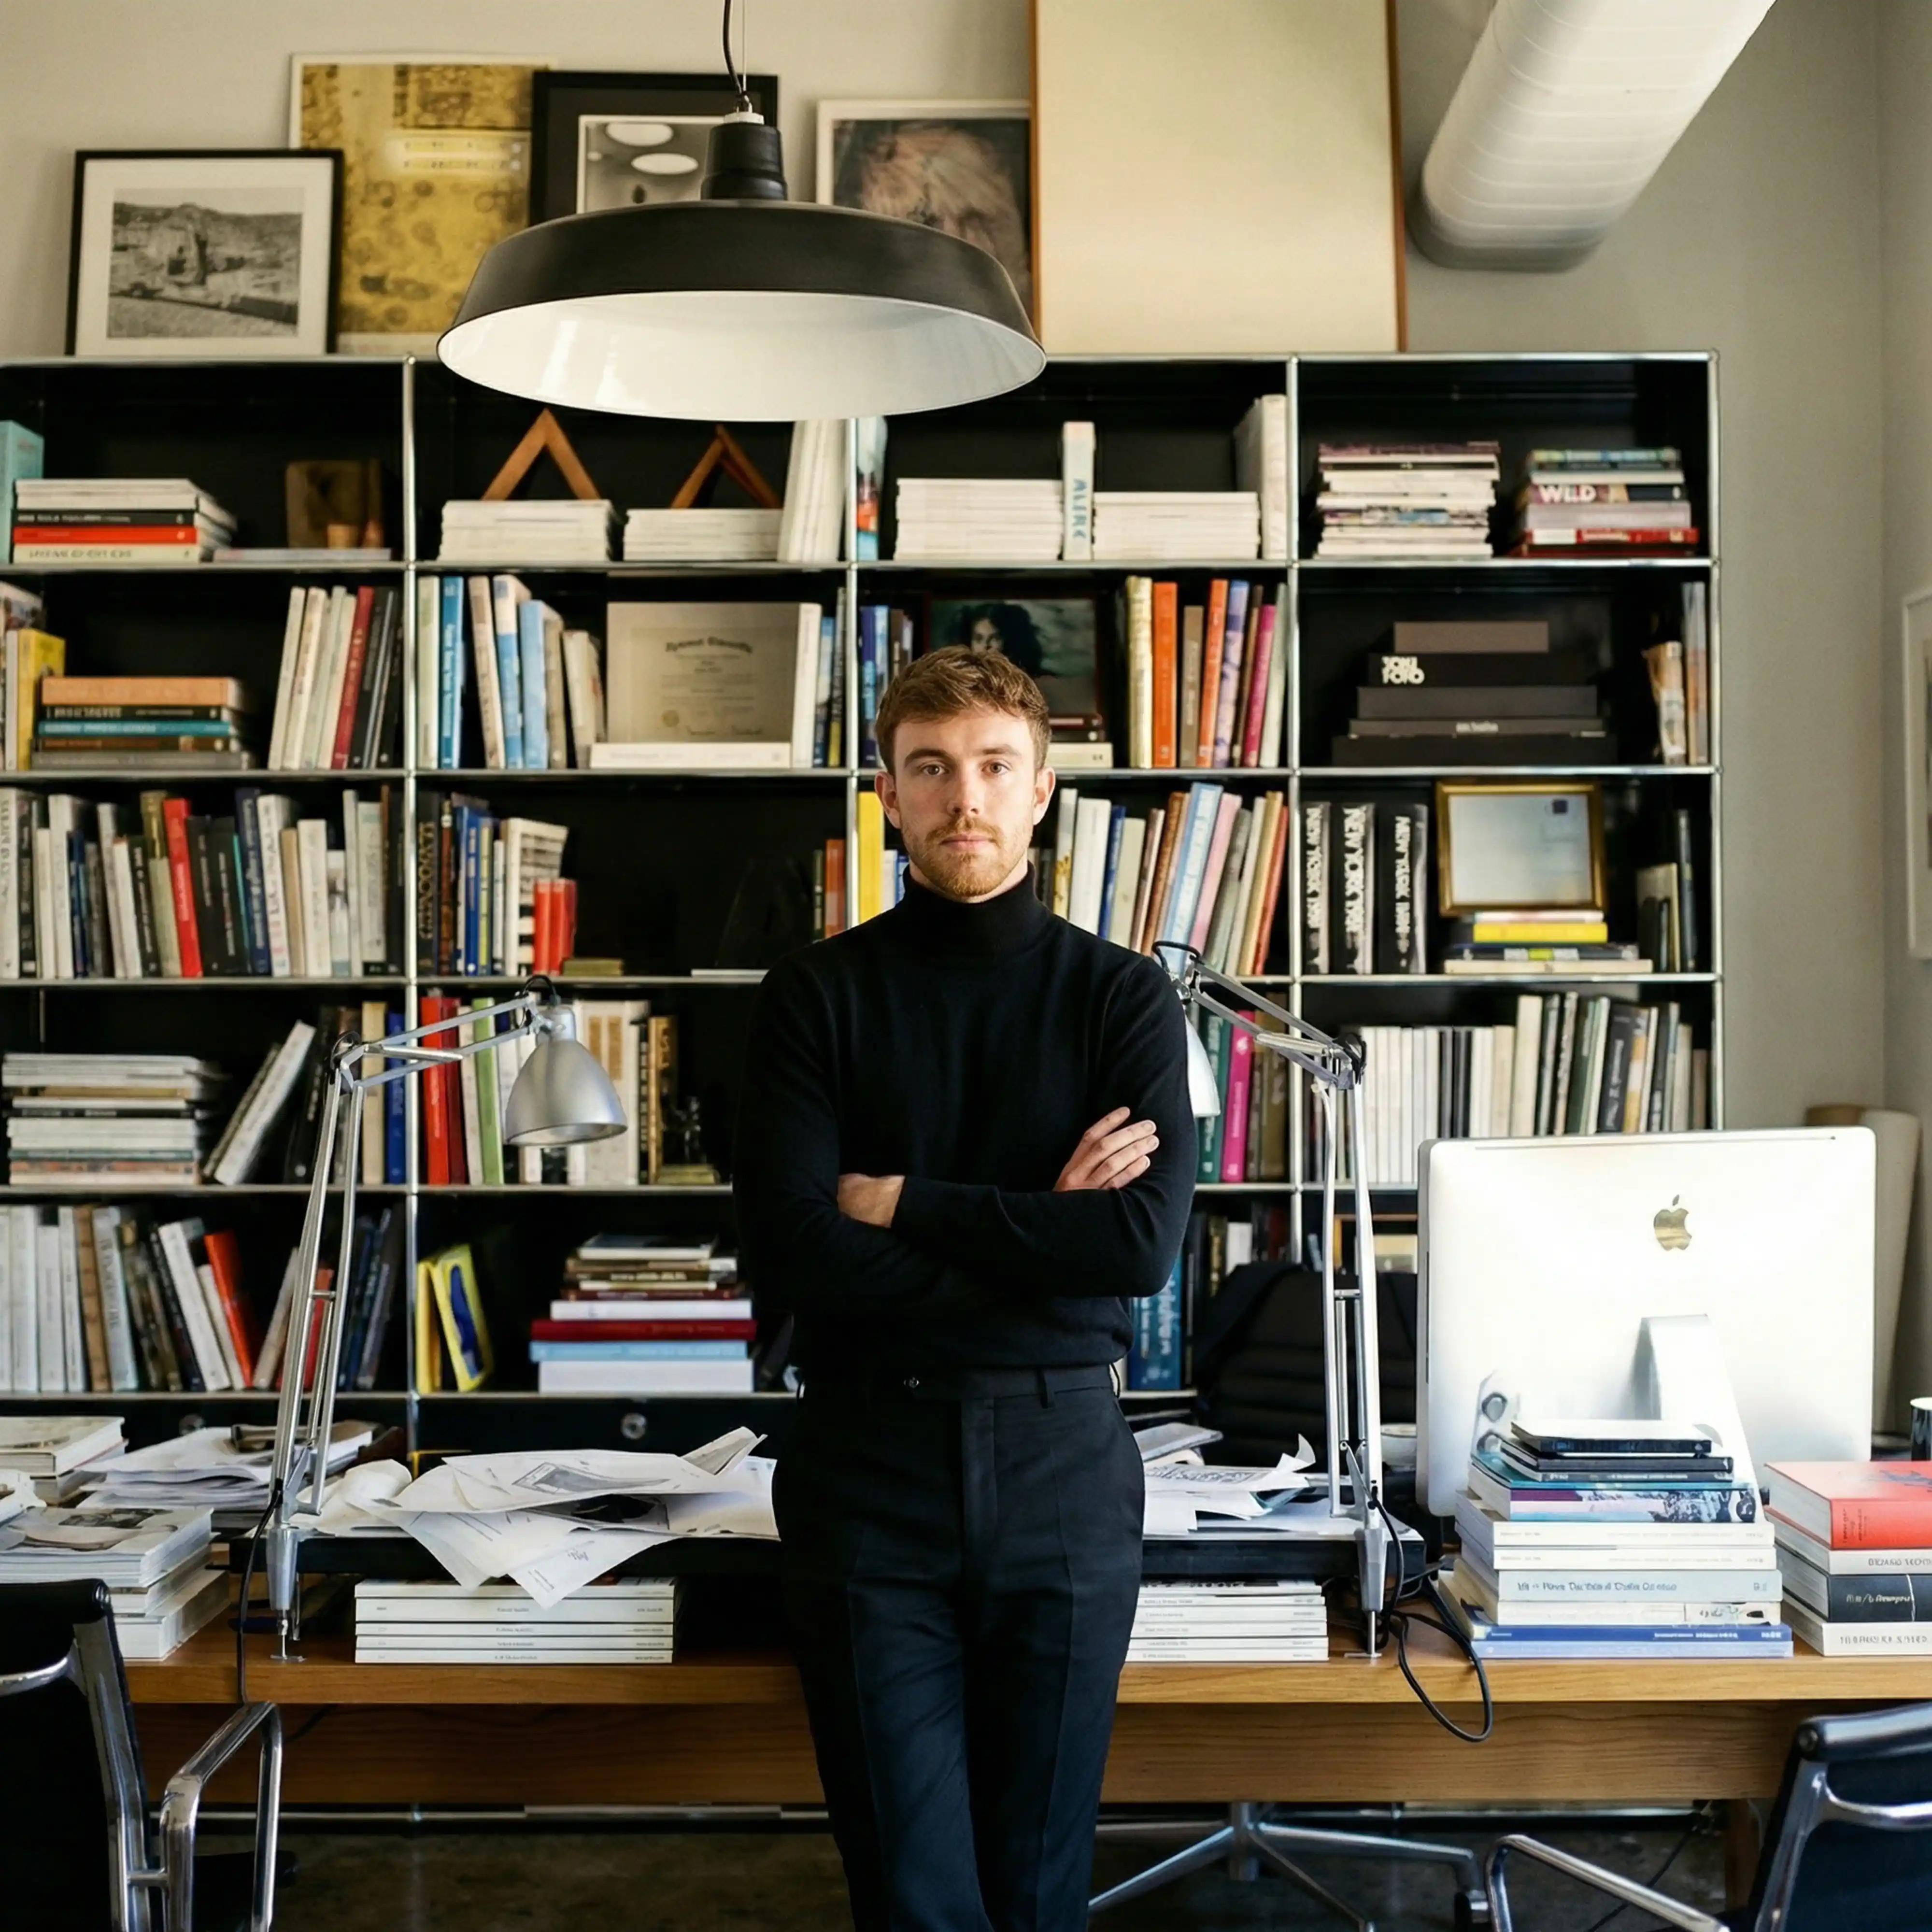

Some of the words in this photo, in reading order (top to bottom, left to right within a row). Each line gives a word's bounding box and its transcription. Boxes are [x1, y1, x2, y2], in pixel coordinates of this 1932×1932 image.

[1539, 485, 1596, 503] WILD
[1343, 806, 1366, 848] NEW
[1344, 847, 1364, 897] YORK
